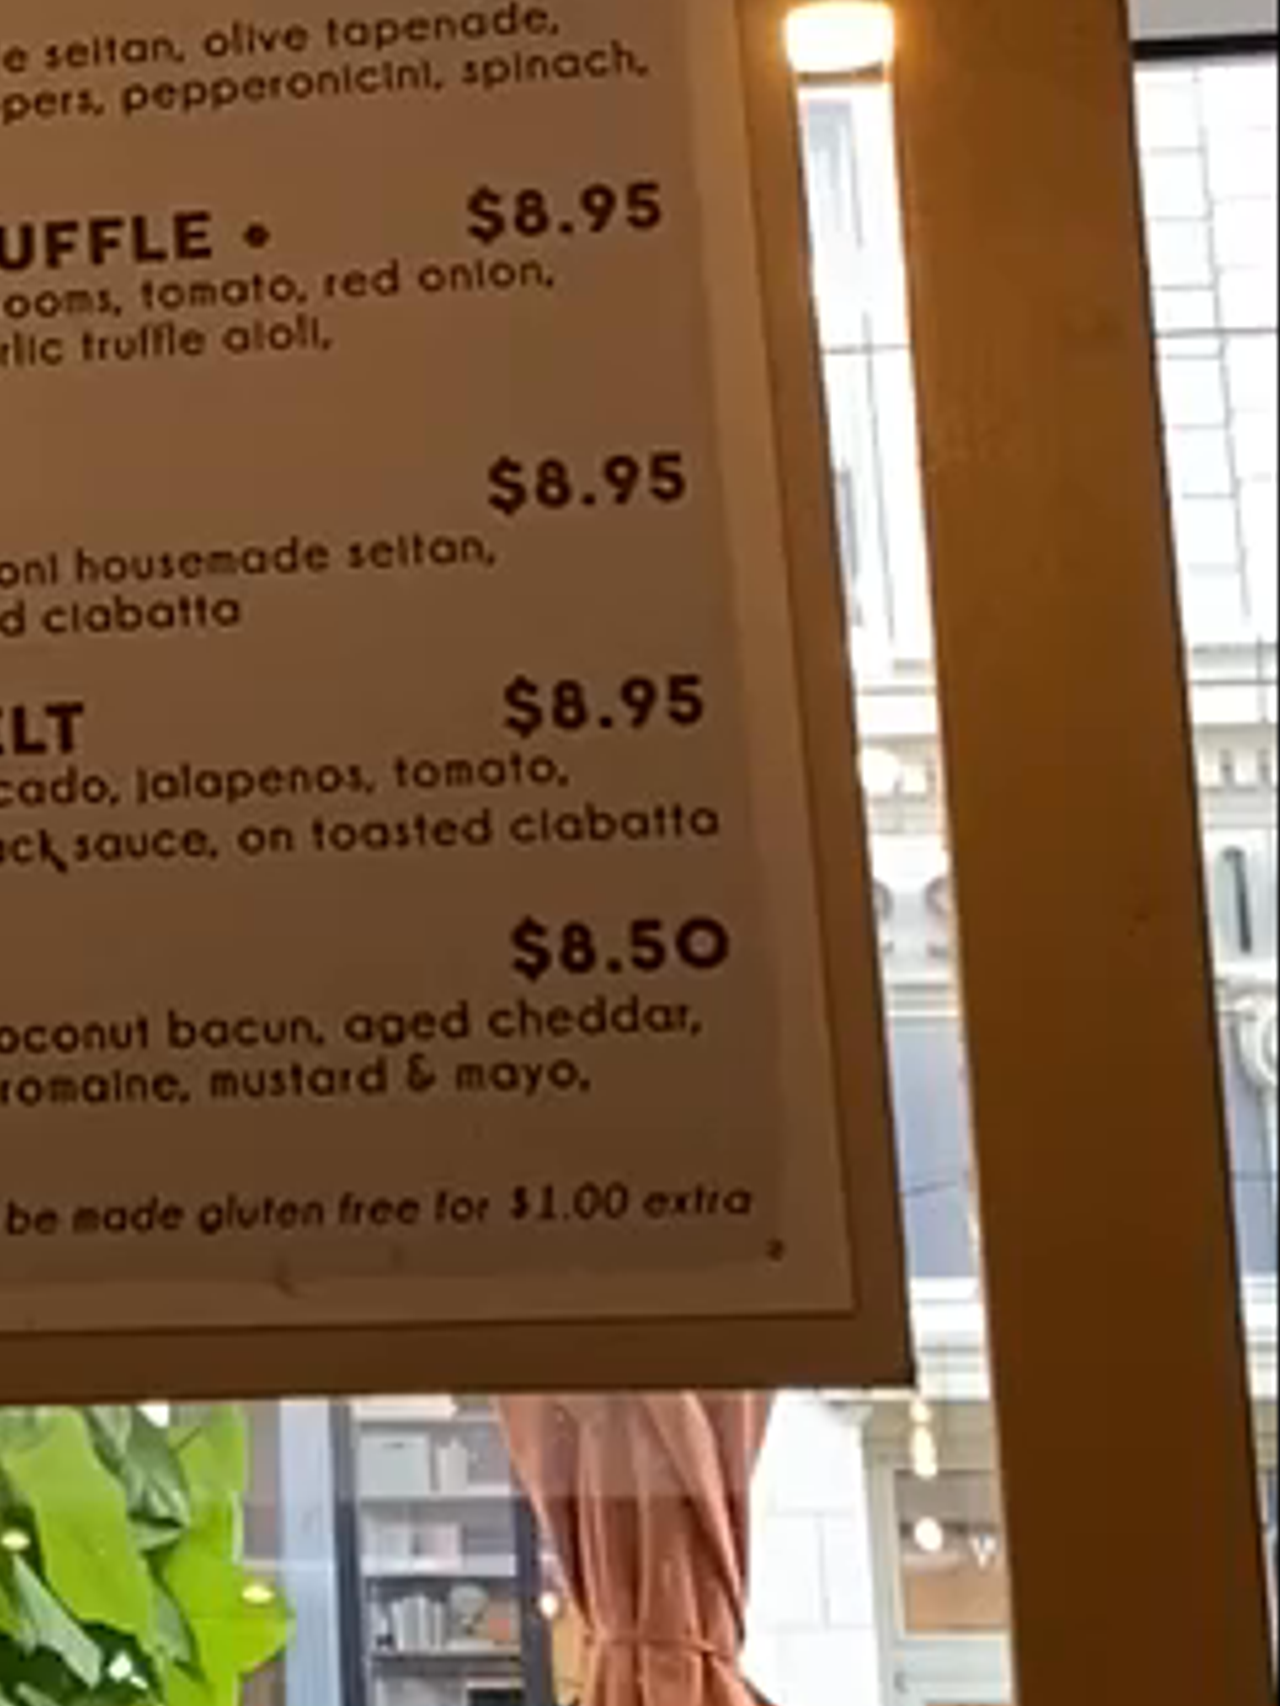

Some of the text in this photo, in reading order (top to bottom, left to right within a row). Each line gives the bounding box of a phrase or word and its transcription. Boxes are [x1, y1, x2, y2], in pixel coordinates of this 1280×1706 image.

[200, 19, 311, 60] olive
[464, 178, 665, 248] $8.95
[322, 256, 402, 300] red
[485, 449, 688, 518] $8.95
[38, 591, 243, 637] ciabatta
[501, 672, 707, 743] $8.95
[235, 823, 297, 858] on
[309, 805, 496, 853] toasted
[506, 799, 722, 846] ciabatta
[508, 913, 732, 986] $8.50
[342, 997, 473, 1051] aged
[2, 1199, 61, 1238] be
[70, 1194, 187, 1236] made
[194, 1192, 326, 1238] gluten
[337, 1190, 422, 1228] free
[433, 1188, 492, 1226] for
[508, 1179, 631, 1223] $1.00
[641, 1182, 754, 1221] extra
